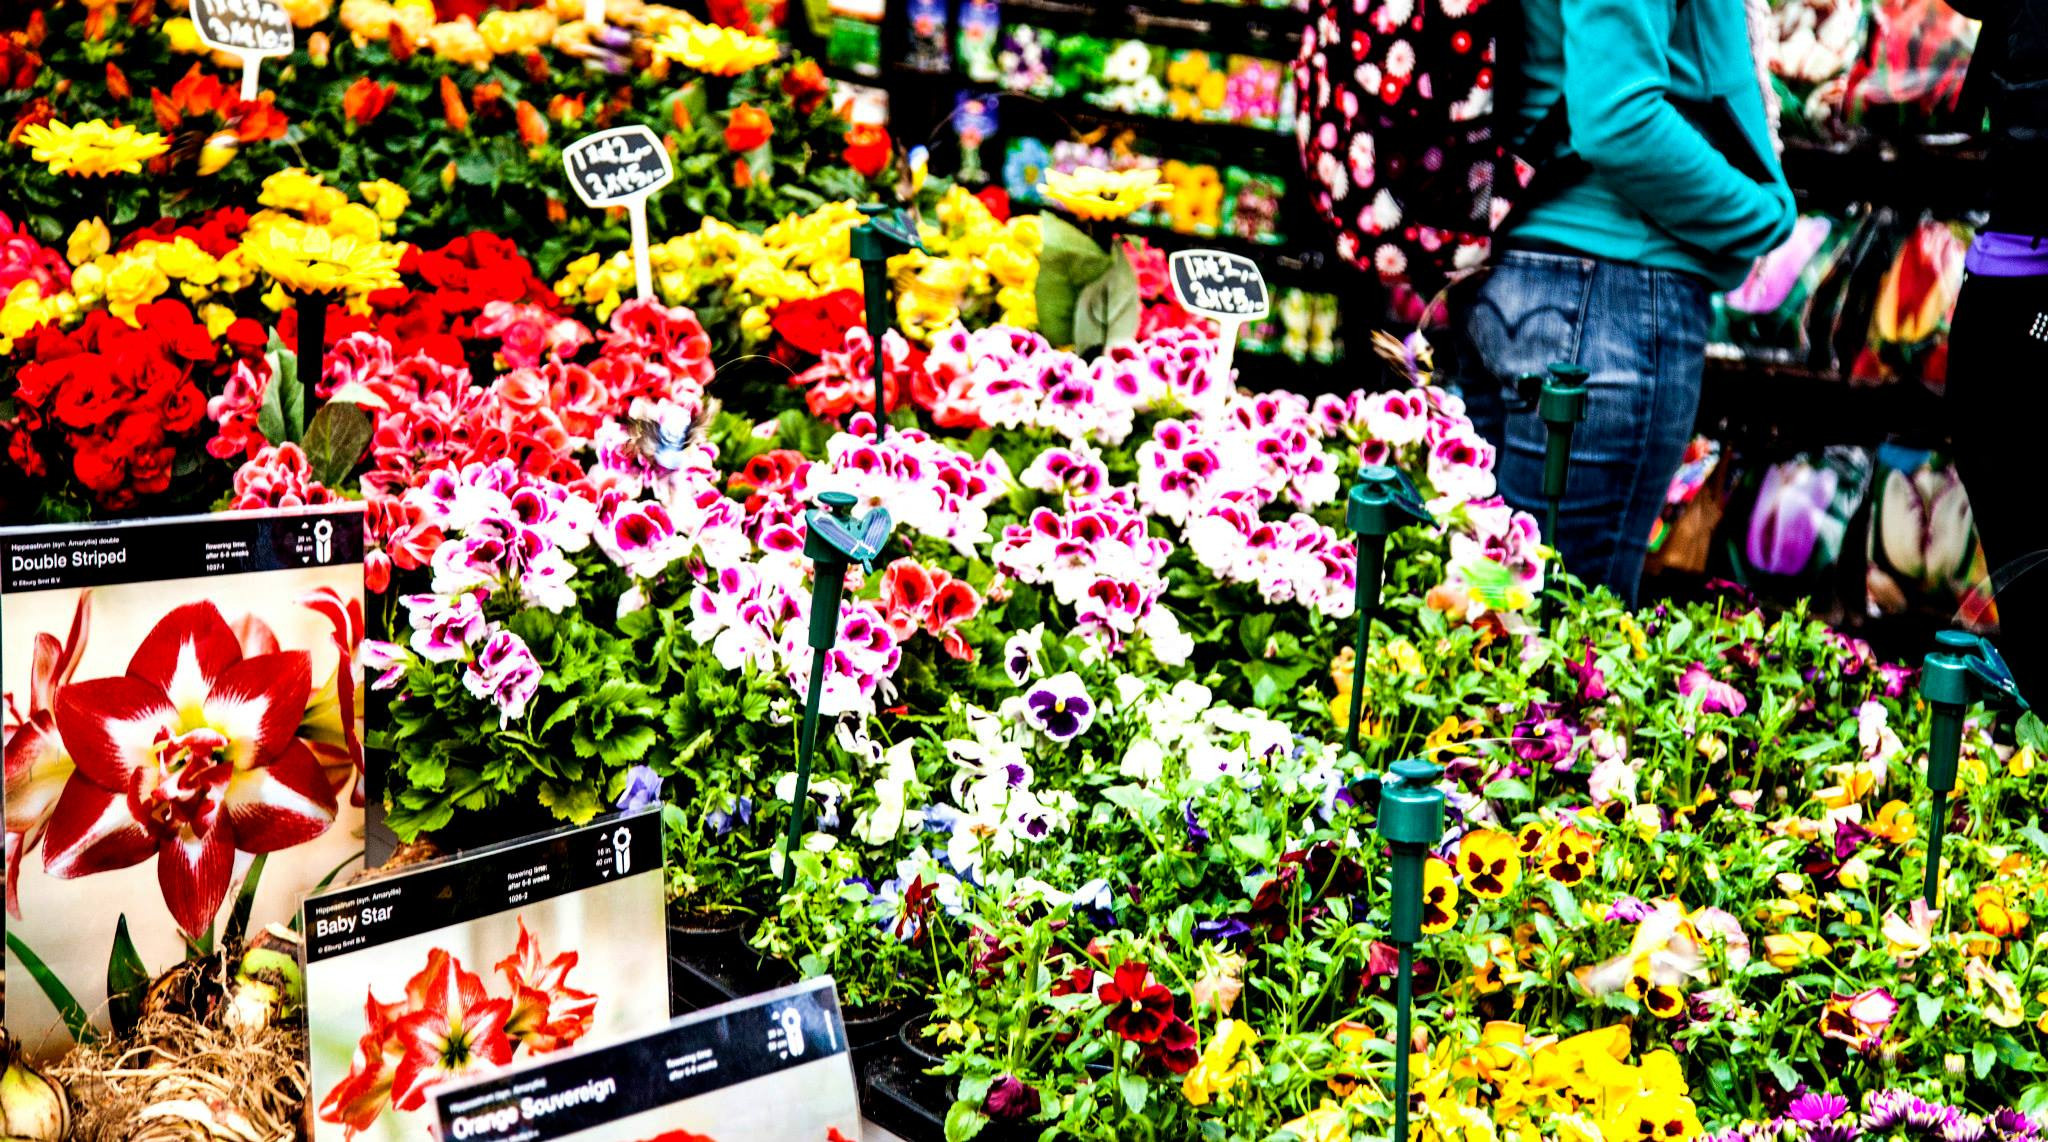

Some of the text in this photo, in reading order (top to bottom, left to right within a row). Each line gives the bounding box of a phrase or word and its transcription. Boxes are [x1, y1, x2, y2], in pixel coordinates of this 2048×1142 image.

[11, 537, 119, 552] Hippeastrum (syn. Amaryllis) double
[206, 542, 231, 551] flowering
[12, 547, 127, 572] Double Striped
[206, 552, 219, 560] after
[231, 550, 249, 558] weeks
[507, 868, 533, 881] flowering
[508, 881, 520, 891] after
[532, 873, 550, 885] weeks
[316, 887, 401, 915] Hippeastrum (syn. Amaryllis)
[316, 905, 393, 938] Baby Star
[452, 1077, 617, 1140] Orange Souvereign
